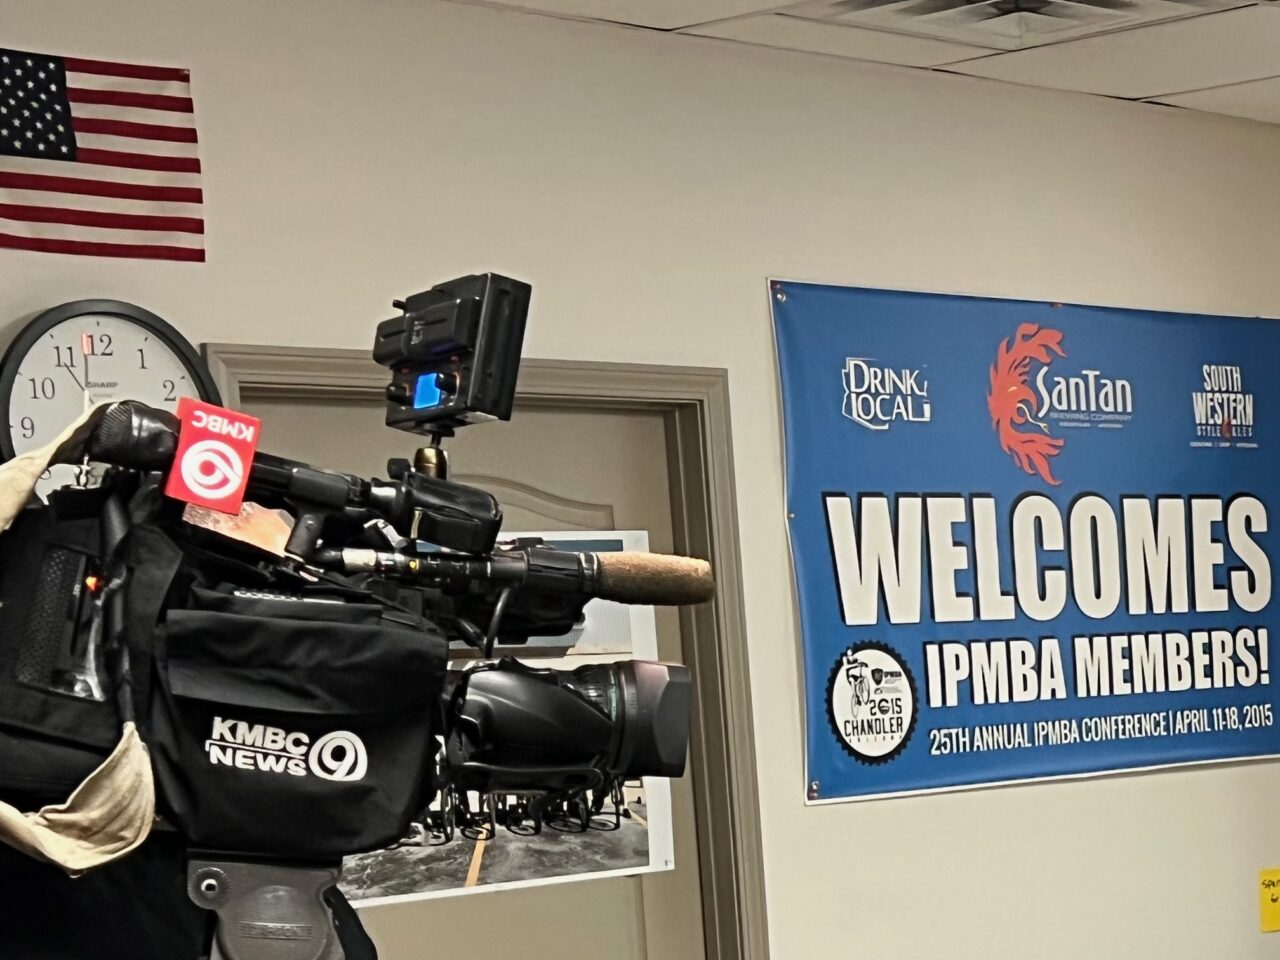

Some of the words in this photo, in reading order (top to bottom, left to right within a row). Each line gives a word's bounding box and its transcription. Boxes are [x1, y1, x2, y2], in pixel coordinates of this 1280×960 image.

[54, 345, 77, 368] 11
[87, 334, 113, 356] 12
[137, 348, 148, 369] 1
[29, 377, 55, 400] 10
[162, 379, 176, 401] 2
[849, 360, 924, 395] DRINK
[1036, 366, 1132, 418] SanTan
[1202, 364, 1241, 391] SOUTH
[850, 393, 926, 428] LOCAL
[1192, 392, 1253, 425] WESTERN
[21, 416, 35, 439] 9
[192, 410, 254, 442] KMBC
[1197, 425, 1221, 436] STYLE
[825, 495, 1271, 626] WELCOMES
[925, 636, 1067, 708] IPMBA
[1074, 627, 1270, 698] MEMBERS!
[869, 697, 902, 716] 2015
[212, 716, 310, 755] KMBC
[844, 716, 903, 737] CHANDLER
[929, 727, 970, 755] 25TH
[973, 723, 1032, 752] ANNUAL
[1034, 719, 1080, 746] IPMBA
[1082, 712, 1167, 742] CONFERENCE
[1175, 709, 1211, 735] APRIL
[1212, 706, 1242, 731] 11-18,
[1244, 703, 1273, 728] 2015
[209, 745, 307, 776] NEWS
